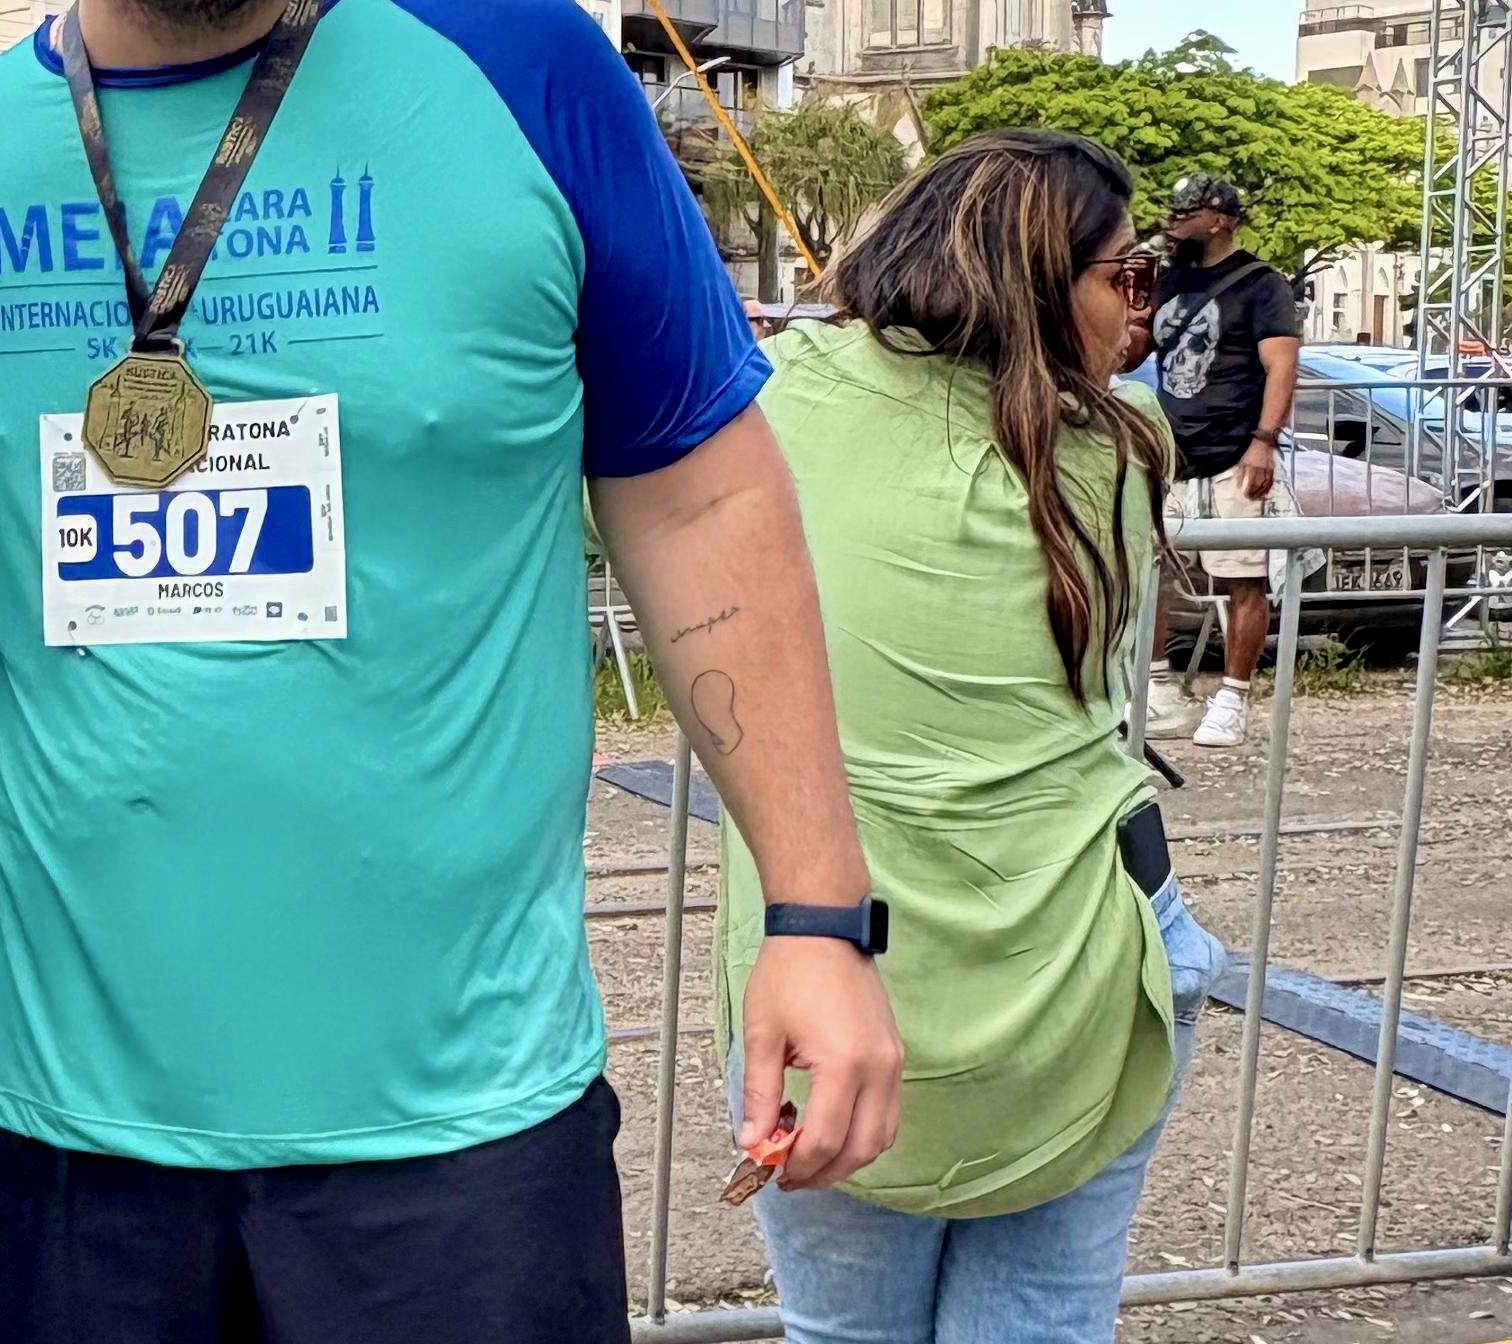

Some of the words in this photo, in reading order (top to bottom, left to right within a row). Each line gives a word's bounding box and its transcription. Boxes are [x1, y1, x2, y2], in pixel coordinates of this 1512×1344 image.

[224, 187, 313, 224] ARA
[210, 224, 311, 261] ONA
[201, 285, 380, 326] URUGUAIANA
[229, 331, 278, 356] 21K
[208, 420, 291, 442] RATONA
[58, 527, 94, 549] 10K
[112, 488, 269, 578] 507
[158, 581, 225, 600] MARCOS
